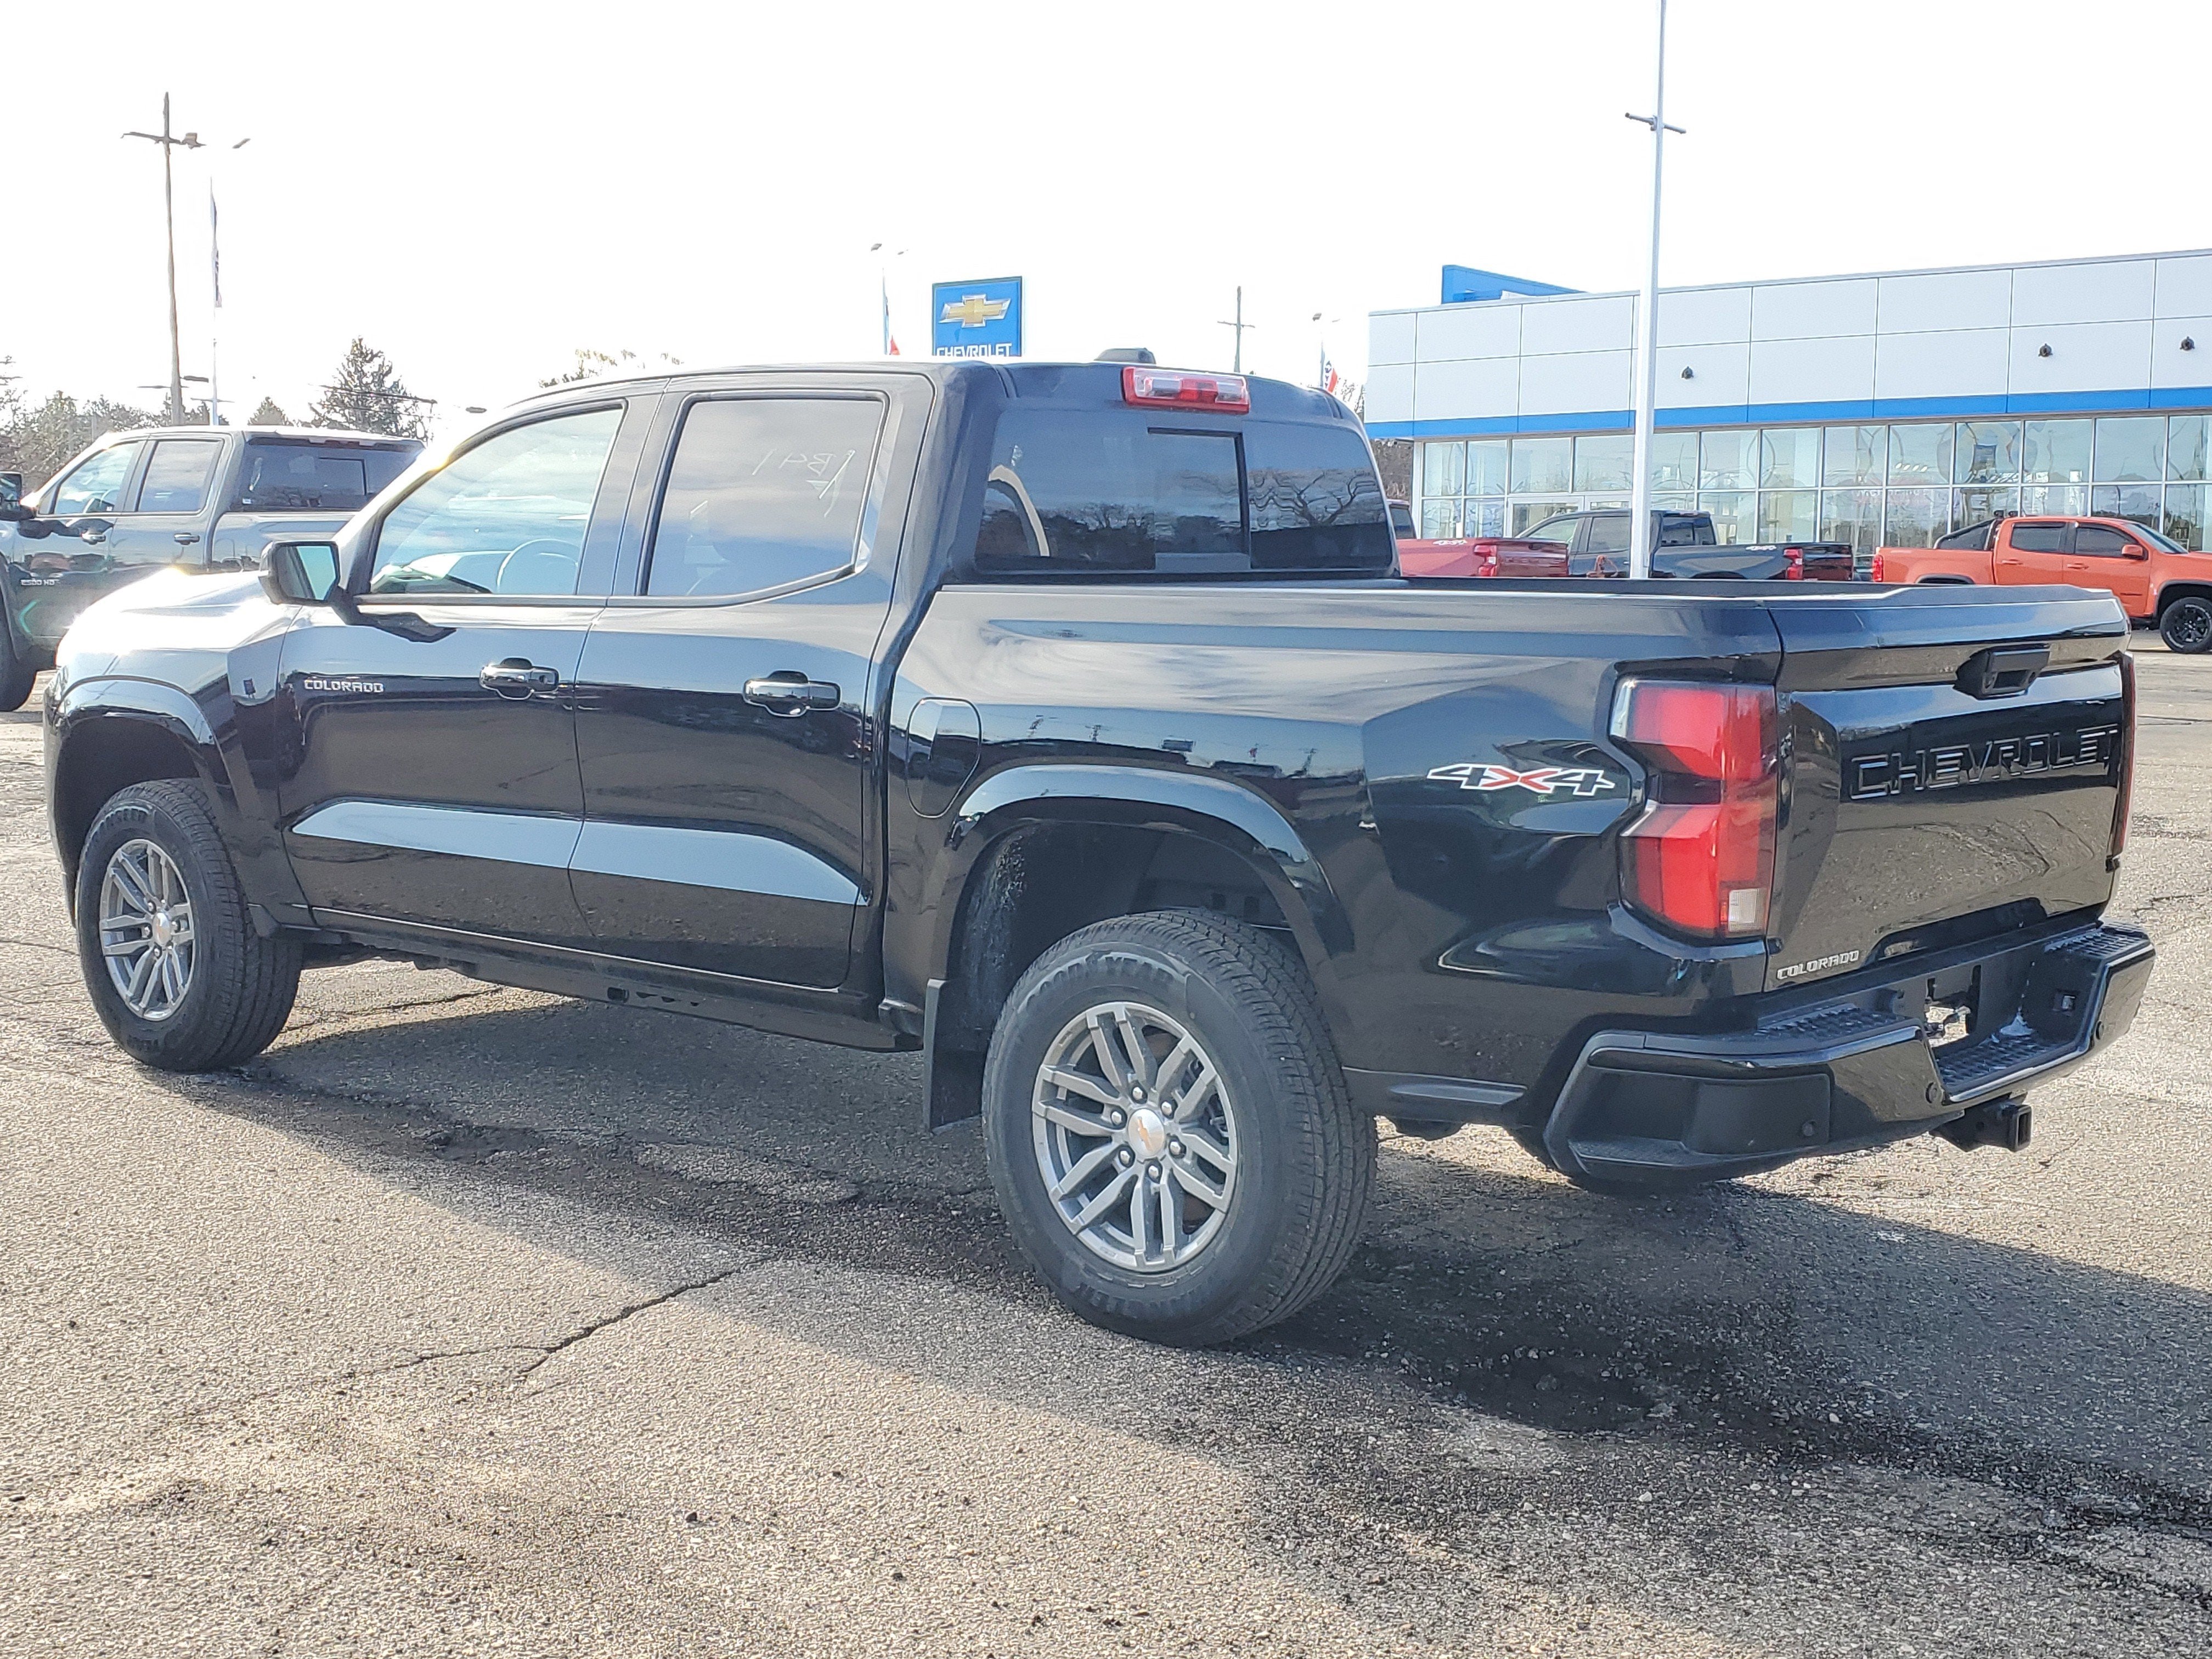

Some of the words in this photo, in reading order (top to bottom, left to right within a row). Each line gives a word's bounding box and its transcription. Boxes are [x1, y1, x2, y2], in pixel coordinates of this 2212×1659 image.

[936, 343, 1012, 357] CHEVROLET
[304, 679, 384, 693] COLORADO
[1849, 723, 2118, 800] CHEVROLET
[1776, 950, 1860, 979] COLORADO
